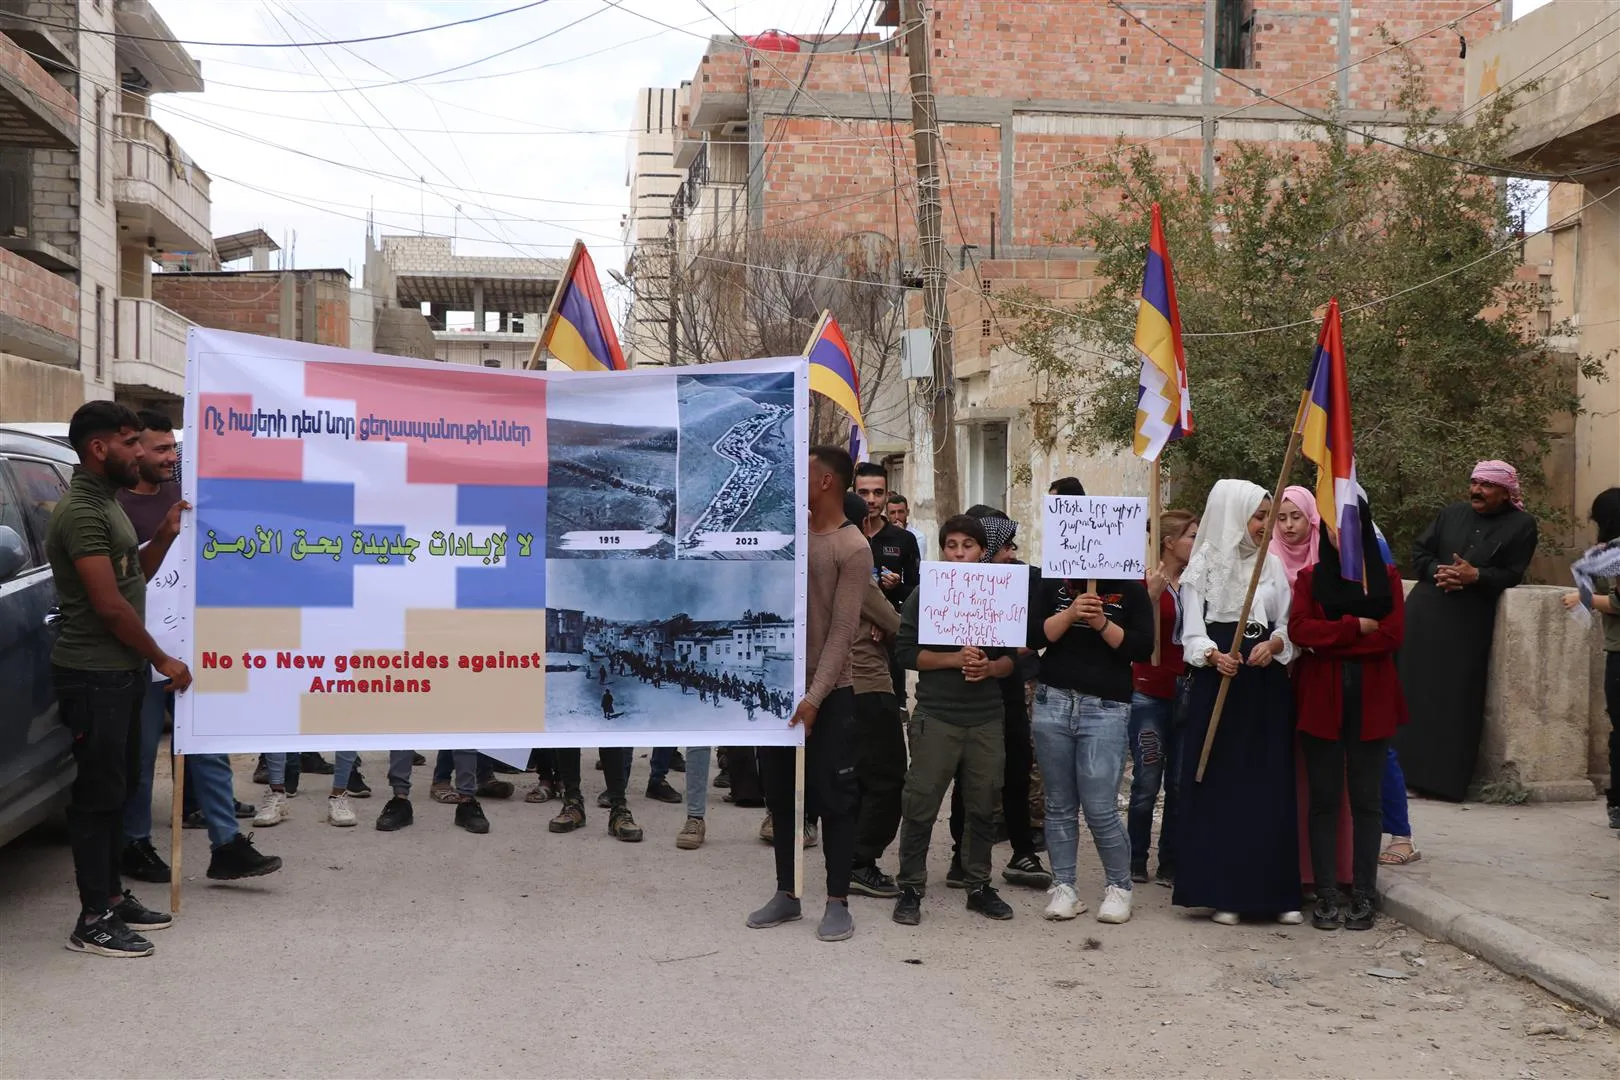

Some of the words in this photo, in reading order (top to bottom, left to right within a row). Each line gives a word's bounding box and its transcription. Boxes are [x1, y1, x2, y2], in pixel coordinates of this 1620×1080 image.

[205, 406, 225, 436] Ոչ
[229, 407, 287, 437] հայերի
[292, 410, 323, 438] դեմ
[325, 410, 355, 440] նոր
[360, 414, 531, 446] ցեղասպանութիւններ
[202, 524, 283, 560] الأرمن
[291, 529, 343, 561] بحق
[351, 530, 421, 564] جديدة
[428, 530, 509, 565] لإبادات
[516, 532, 534, 557] لا
[599, 536, 621, 545] 1915
[736, 537, 759, 546] 2023
[202, 652, 233, 669] No
[242, 653, 267, 669] to
[277, 652, 325, 669] New
[334, 651, 449, 672] genocides
[458, 651, 541, 673] against
[310, 676, 431, 693] Armenians
